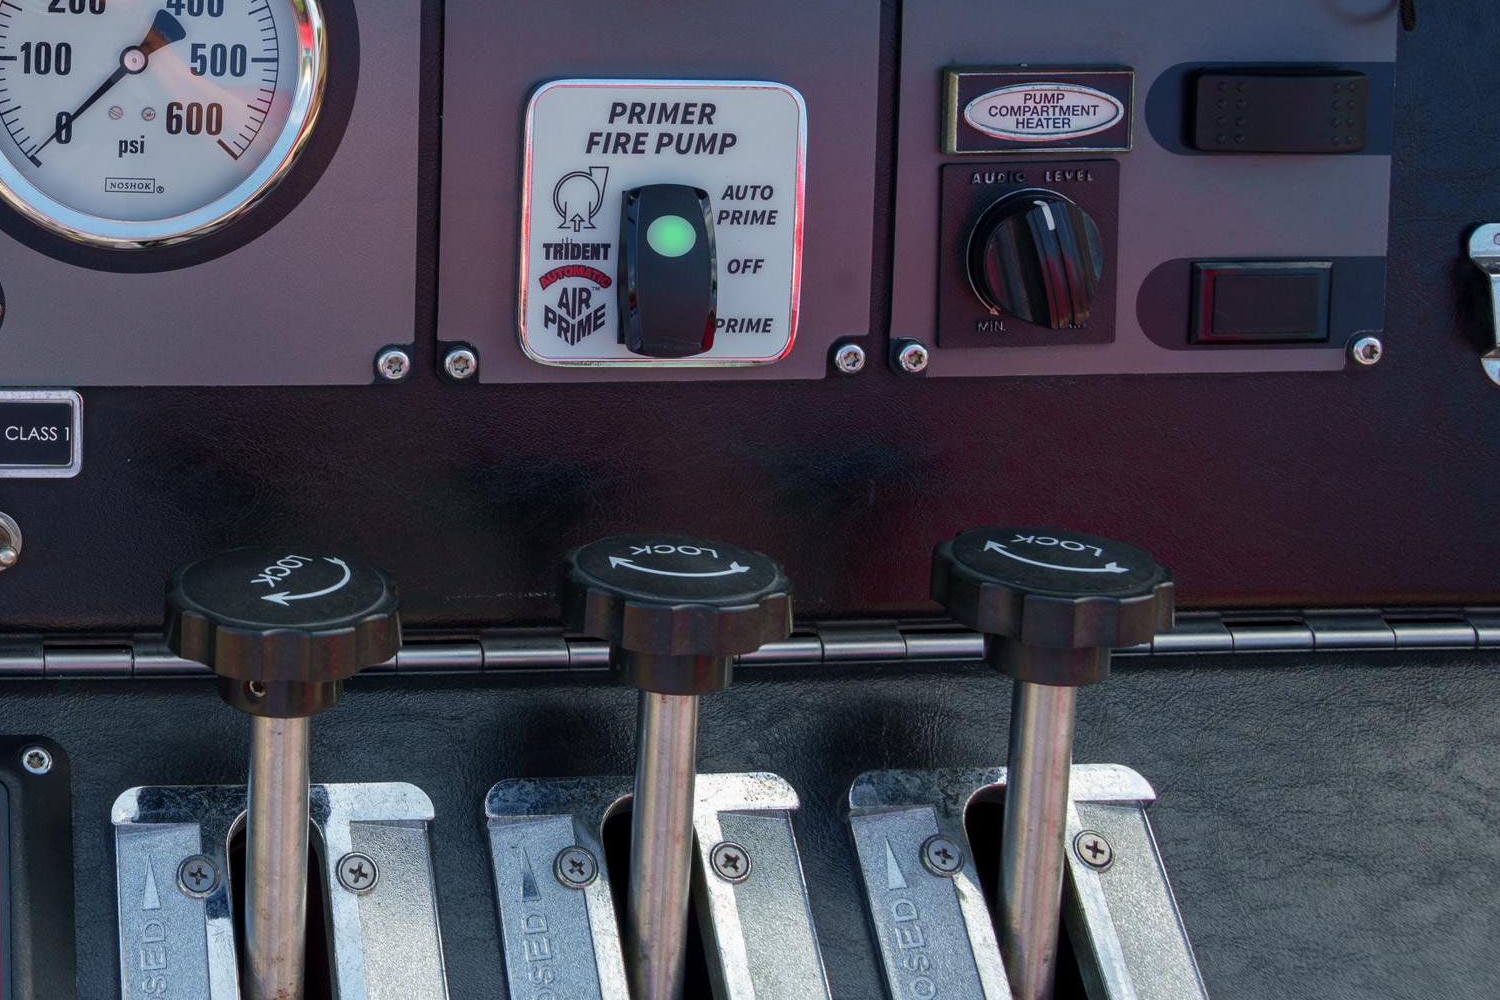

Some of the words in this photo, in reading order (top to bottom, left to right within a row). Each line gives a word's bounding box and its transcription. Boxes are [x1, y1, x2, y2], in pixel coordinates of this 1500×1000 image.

[20, 42, 72, 75] 100
[190, 44, 247, 78] 500
[1023, 93, 1065, 105] PUMP
[165, 102, 224, 136] 600
[608, 102, 716, 125] PRIMER
[988, 105, 1099, 117] COMPARTMENT
[55, 111, 72, 145] 0
[1015, 117, 1071, 129] HEATER
[118, 136, 145, 158] psi
[585, 132, 648, 154] FIRE
[655, 132, 737, 155] PUMP
[1045, 170, 1093, 182] LEVEL
[110, 181, 152, 191] NOSHOK
[721, 185, 774, 201] AUTO
[717, 209, 778, 225] PRIME
[543, 242, 611, 261] TRIDENT
[727, 259, 764, 275] OFF
[557, 287, 591, 320] AIR
[544, 303, 606, 346] PRIME
[715, 318, 773, 333] PRIME
[5, 426, 58, 442] CLASS
[64, 426, 70, 441] 1
[630, 545, 719, 558] LOCK
[1011, 534, 1103, 557] LOCK
[250, 554, 313, 587] LOCK
